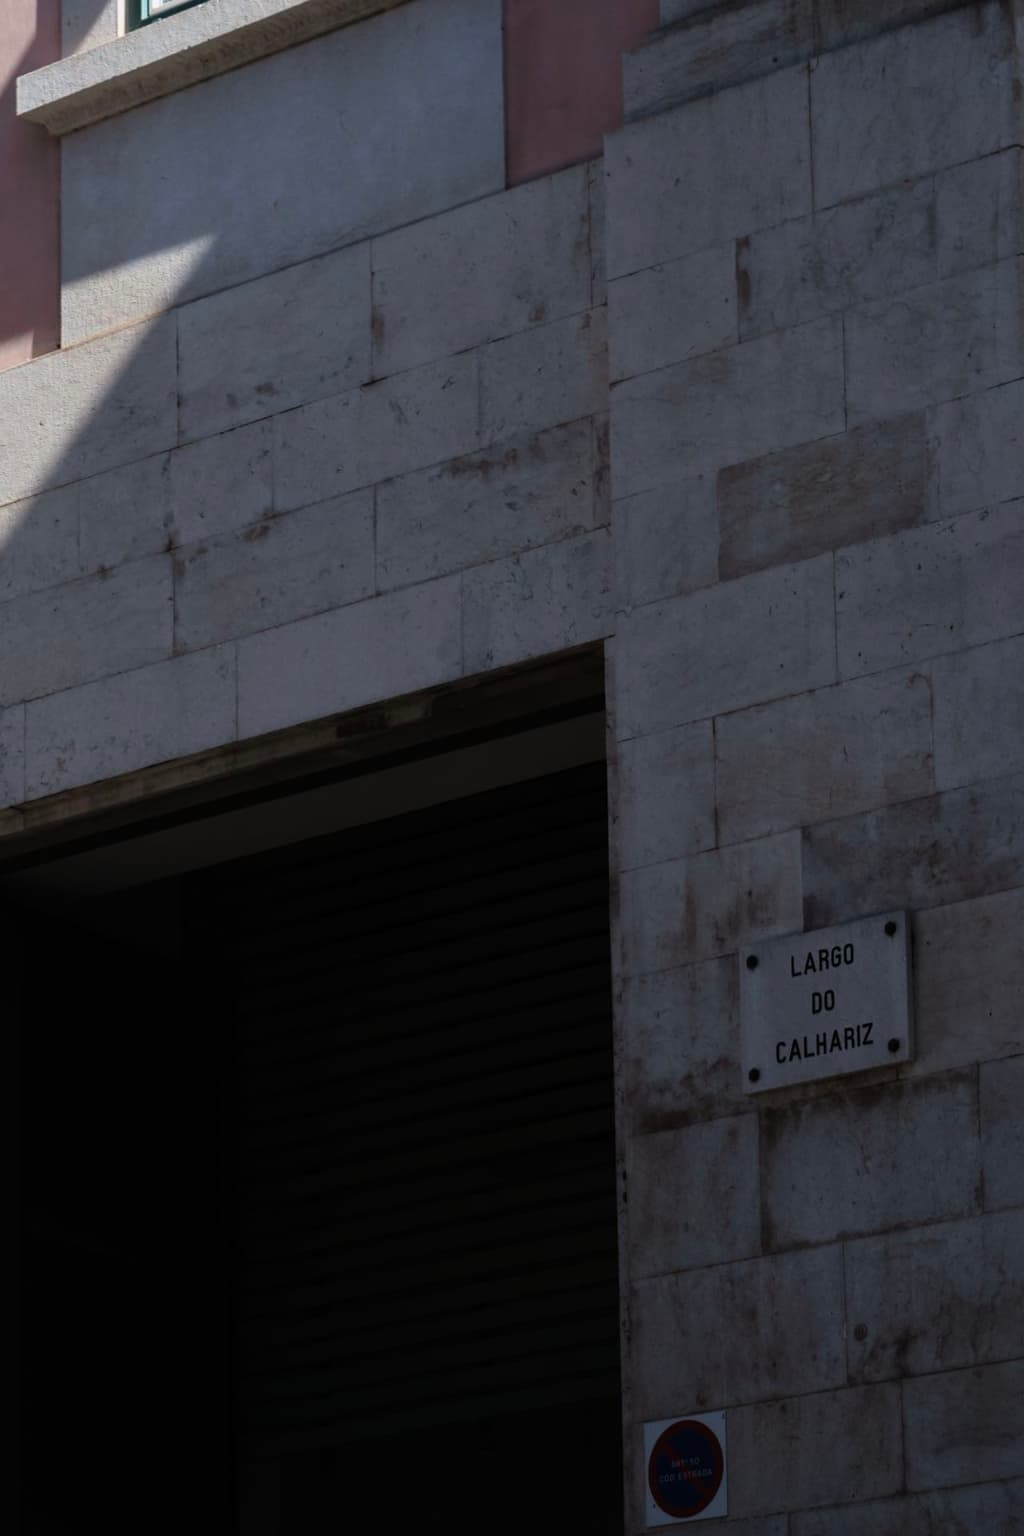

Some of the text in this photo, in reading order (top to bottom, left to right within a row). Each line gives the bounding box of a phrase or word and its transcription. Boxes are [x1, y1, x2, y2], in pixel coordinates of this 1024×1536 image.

[791, 943, 854, 977] LARGO
[812, 990, 835, 1014] DO
[776, 1022, 873, 1063] CALHARIZ
